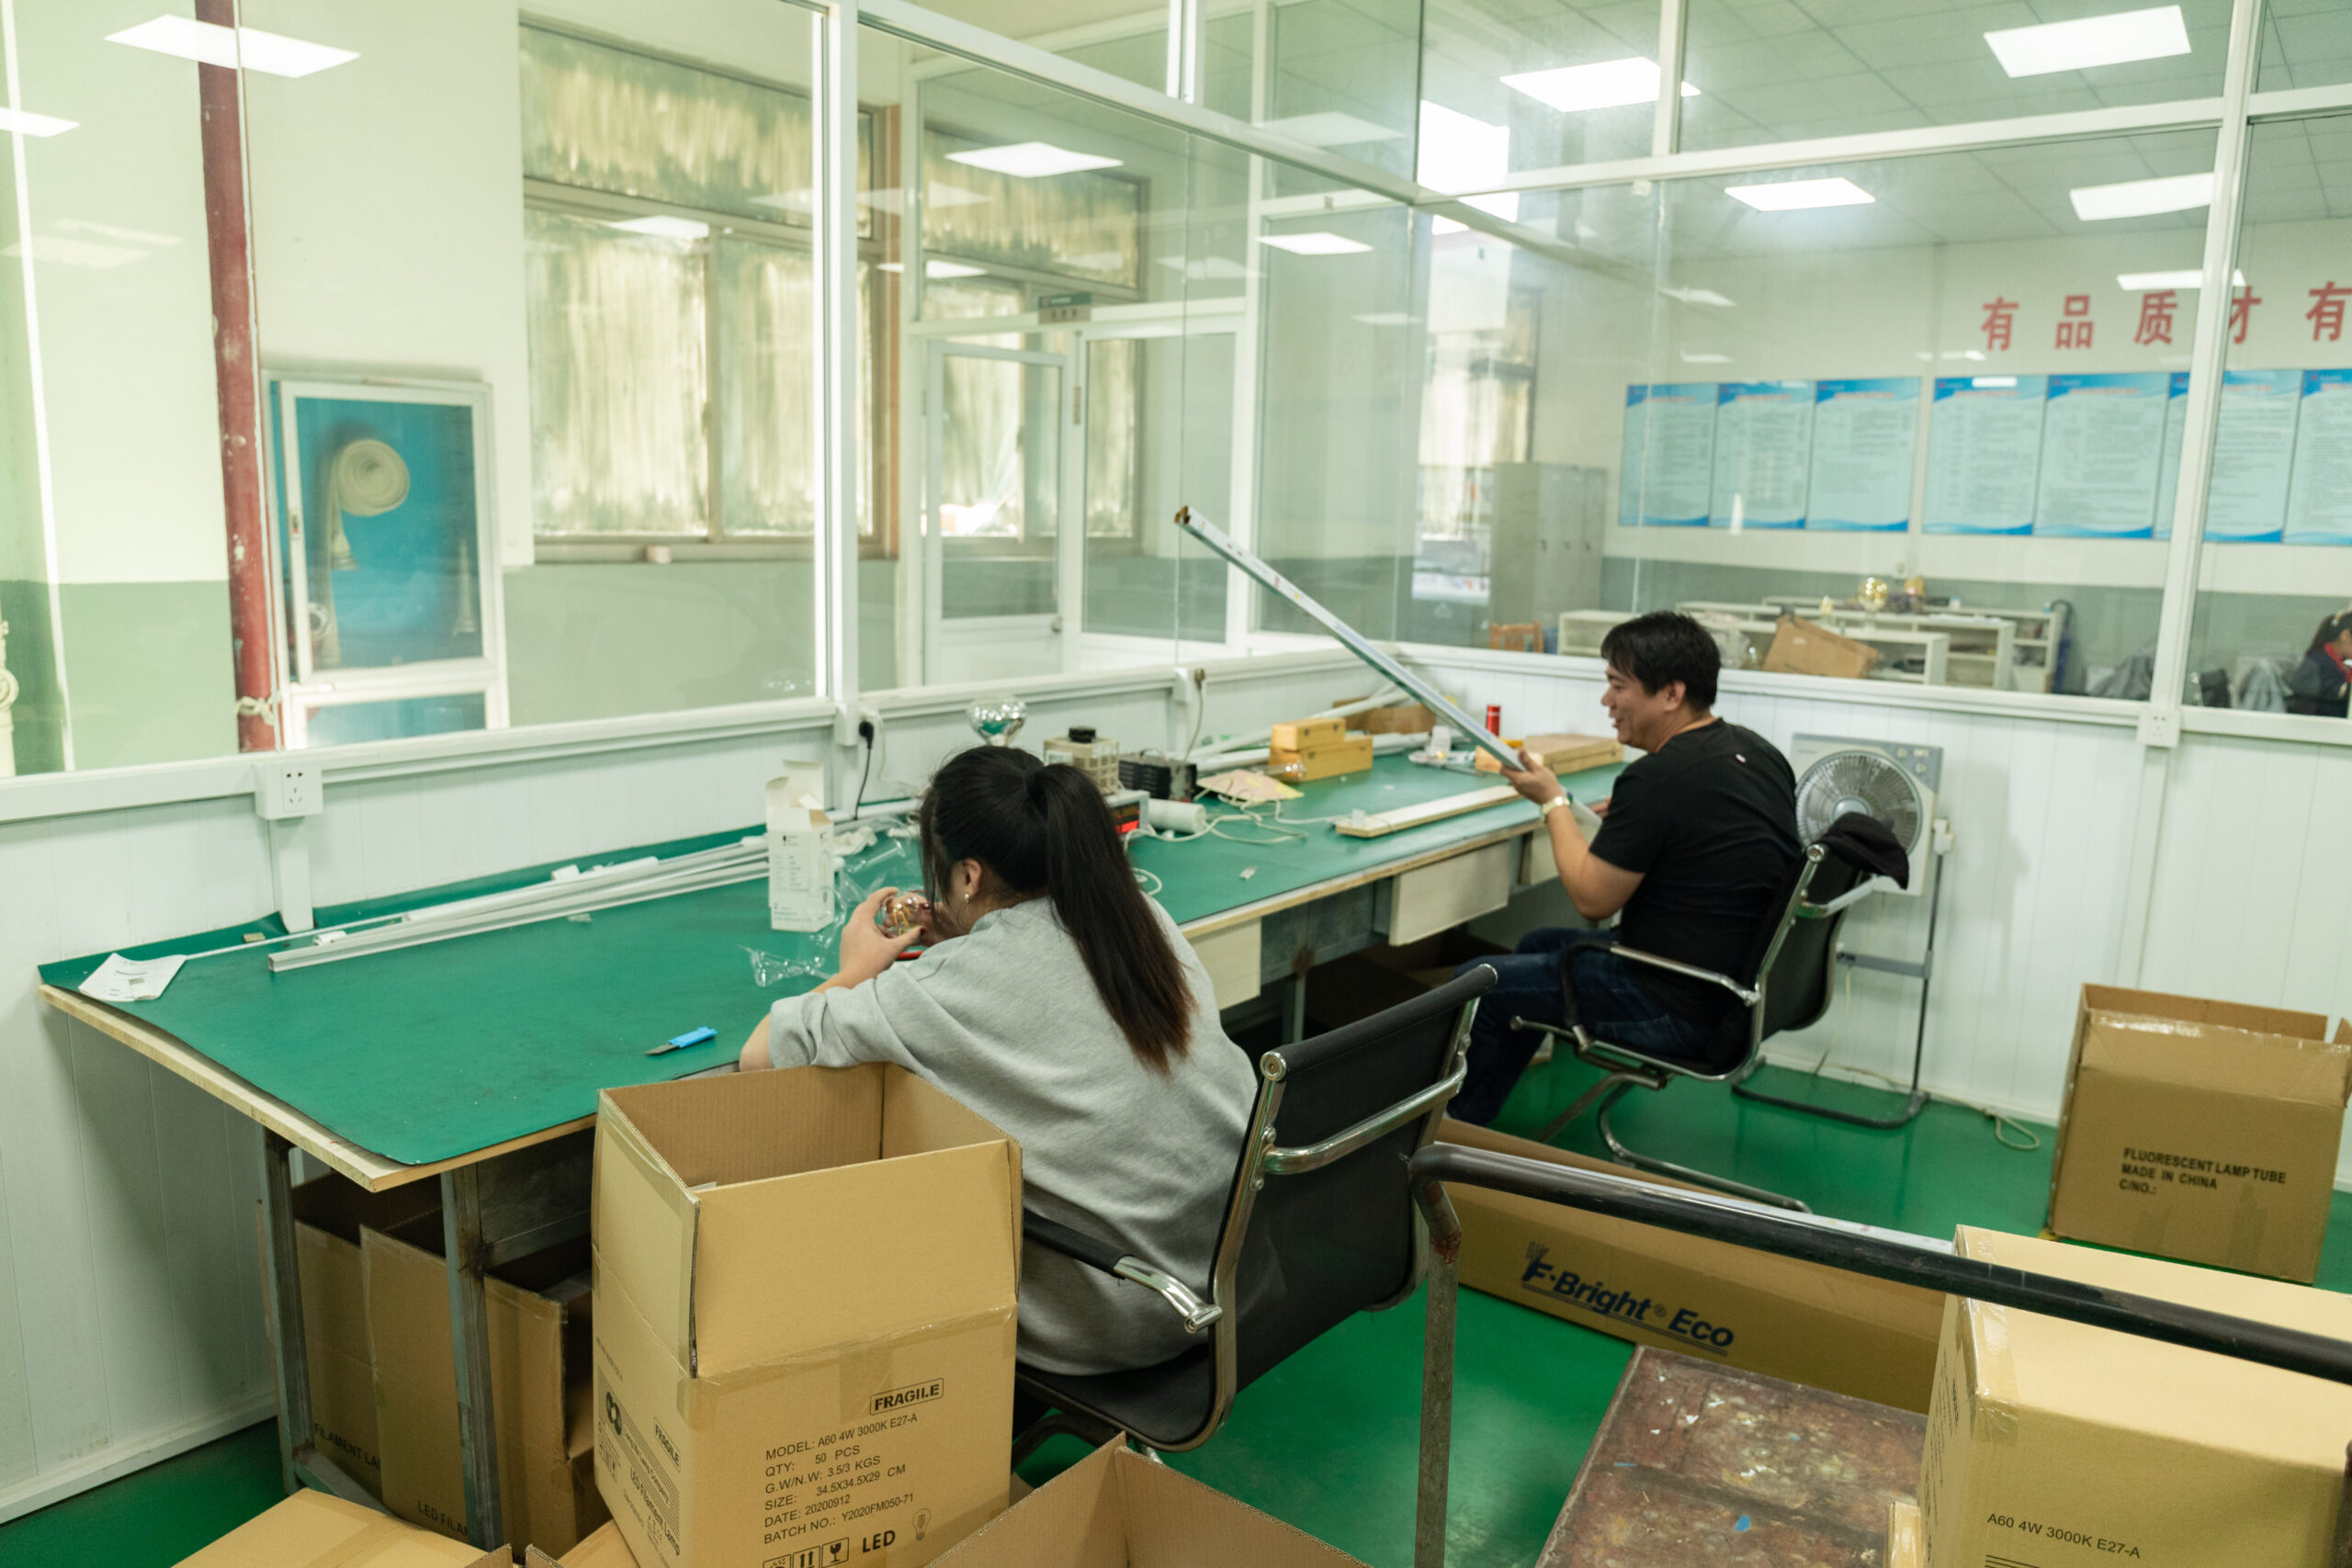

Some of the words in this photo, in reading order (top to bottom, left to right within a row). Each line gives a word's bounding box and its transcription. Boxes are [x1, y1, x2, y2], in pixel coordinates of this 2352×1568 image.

[2121, 1164, 2156, 1179] MADE
[2161, 1170, 2175, 1182] IN
[2178, 1173, 2218, 1190] CHINA
[2215, 1162, 2250, 1178] LAMP
[2253, 1168, 2287, 1184] TUBE
[1668, 1308, 1735, 1348] Eco
[875, 1383, 940, 1412] FRAGILE
[314, 1422, 363, 1460] FILAMENT
[655, 1423, 680, 1468] FRAGILE
[765, 1440, 815, 1461] MODEL:
[818, 1434, 837, 1448] A60
[839, 1428, 855, 1442] 4W
[857, 1420, 888, 1437] 3000K
[889, 1413, 918, 1429] E27-A
[764, 1471, 822, 1494] G.W/N.W:
[828, 1462, 851, 1478] 3.5/3
[854, 1455, 881, 1471] KGS
[765, 1461, 795, 1477] QTY:
[815, 1452, 827, 1465] 50
[834, 1444, 861, 1461] PCS
[764, 1495, 797, 1511] SIZE:
[816, 1471, 880, 1496] 34.5X34.5X29
[887, 1464, 906, 1478] CM
[419, 1499, 438, 1522] LED
[630, 1466, 640, 1491] LED
[640, 1482, 663, 1531] Filament
[664, 1521, 680, 1557] Lamp
[763, 1523, 807, 1545] BATCH
[842, 1493, 914, 1523] Y2020FM050-71
[764, 1510, 801, 1529] DATE:
[805, 1495, 851, 1516] 20200912
[862, 1529, 897, 1553] LED
[1986, 1513, 2015, 1529] A60
[2018, 1520, 2043, 1535] 4W
[2046, 1527, 2093, 1548] 3000K
[2097, 1538, 2141, 1559] E27-A
